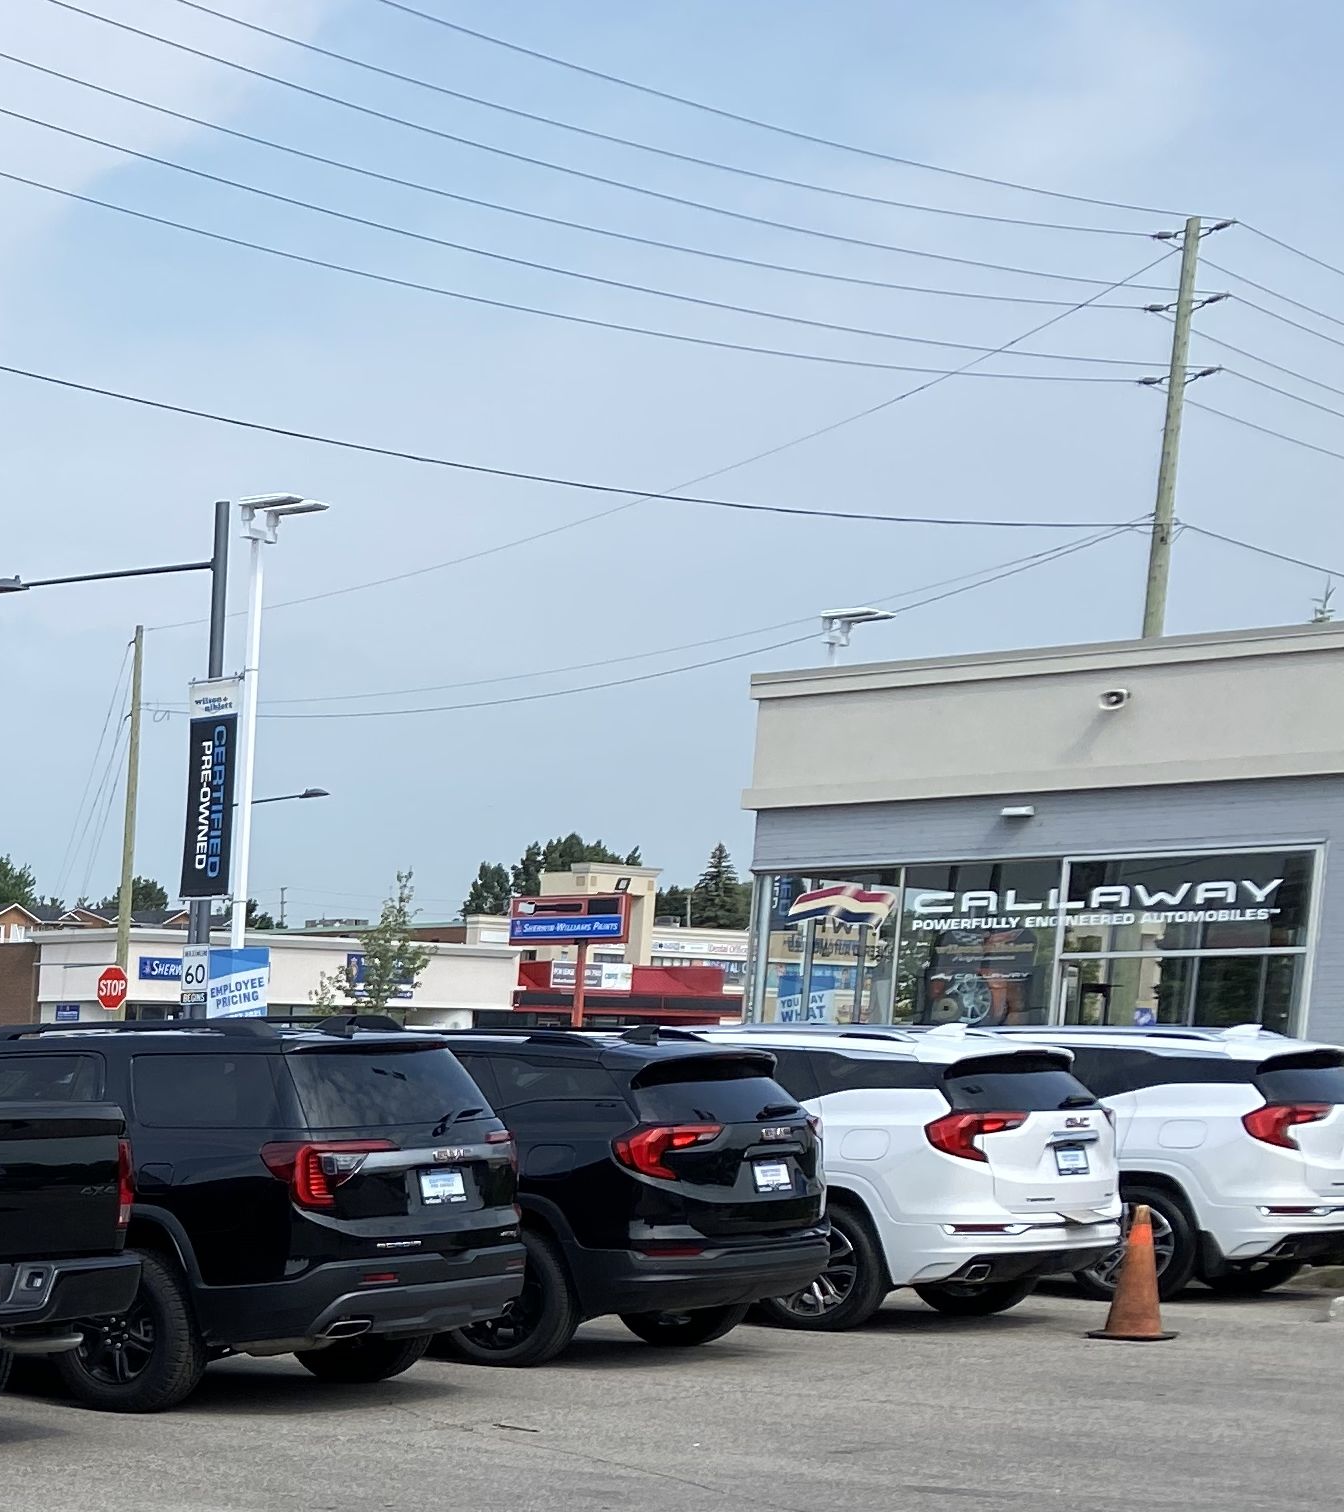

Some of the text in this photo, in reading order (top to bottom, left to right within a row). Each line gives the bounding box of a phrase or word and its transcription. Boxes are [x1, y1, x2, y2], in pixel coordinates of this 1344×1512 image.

[195, 740, 212, 869] PRE-OWNED
[206, 725, 227, 878] CERTIFIED
[913, 878, 1285, 914] CALLAWAY
[593, 921, 618, 931] PAINTS
[912, 916, 1021, 931] POWERFULLY
[1024, 912, 1135, 928] ENGNEERED
[185, 964, 206, 985] 60
[99, 980, 126, 997] STOP
[210, 976, 265, 999] EMPLOYEE
[216, 990, 259, 1009] PRICING
